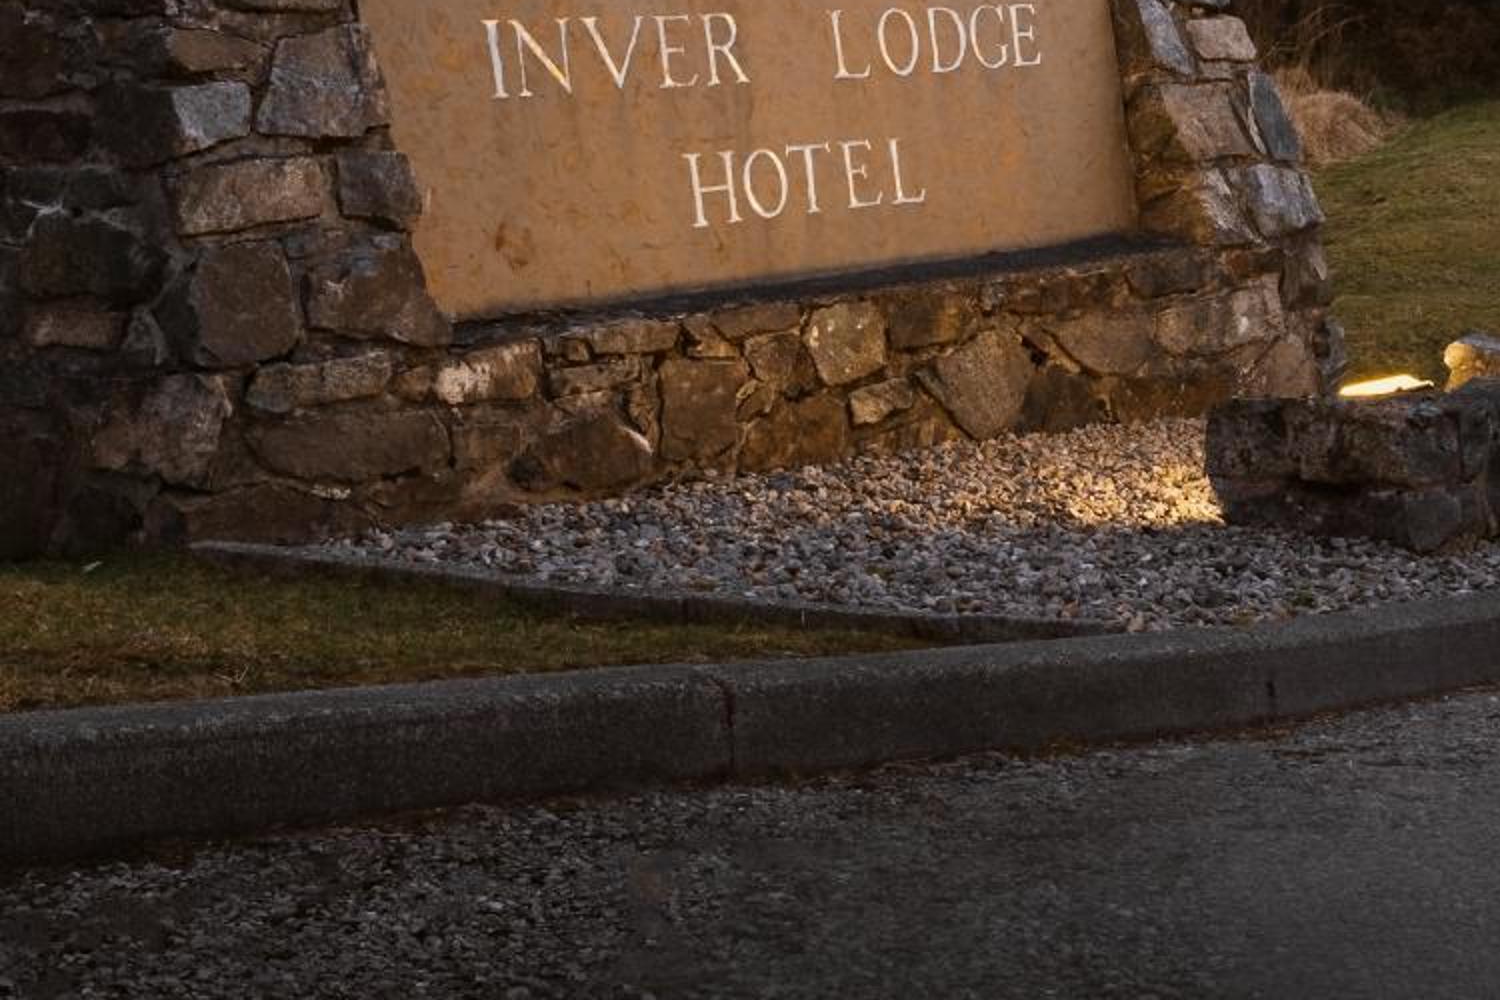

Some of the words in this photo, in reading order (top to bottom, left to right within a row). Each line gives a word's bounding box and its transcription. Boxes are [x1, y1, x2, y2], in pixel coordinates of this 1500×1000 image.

[481, 12, 750, 99] INVER
[829, 3, 1042, 80] LODGE
[682, 138, 926, 229] HOTEL
